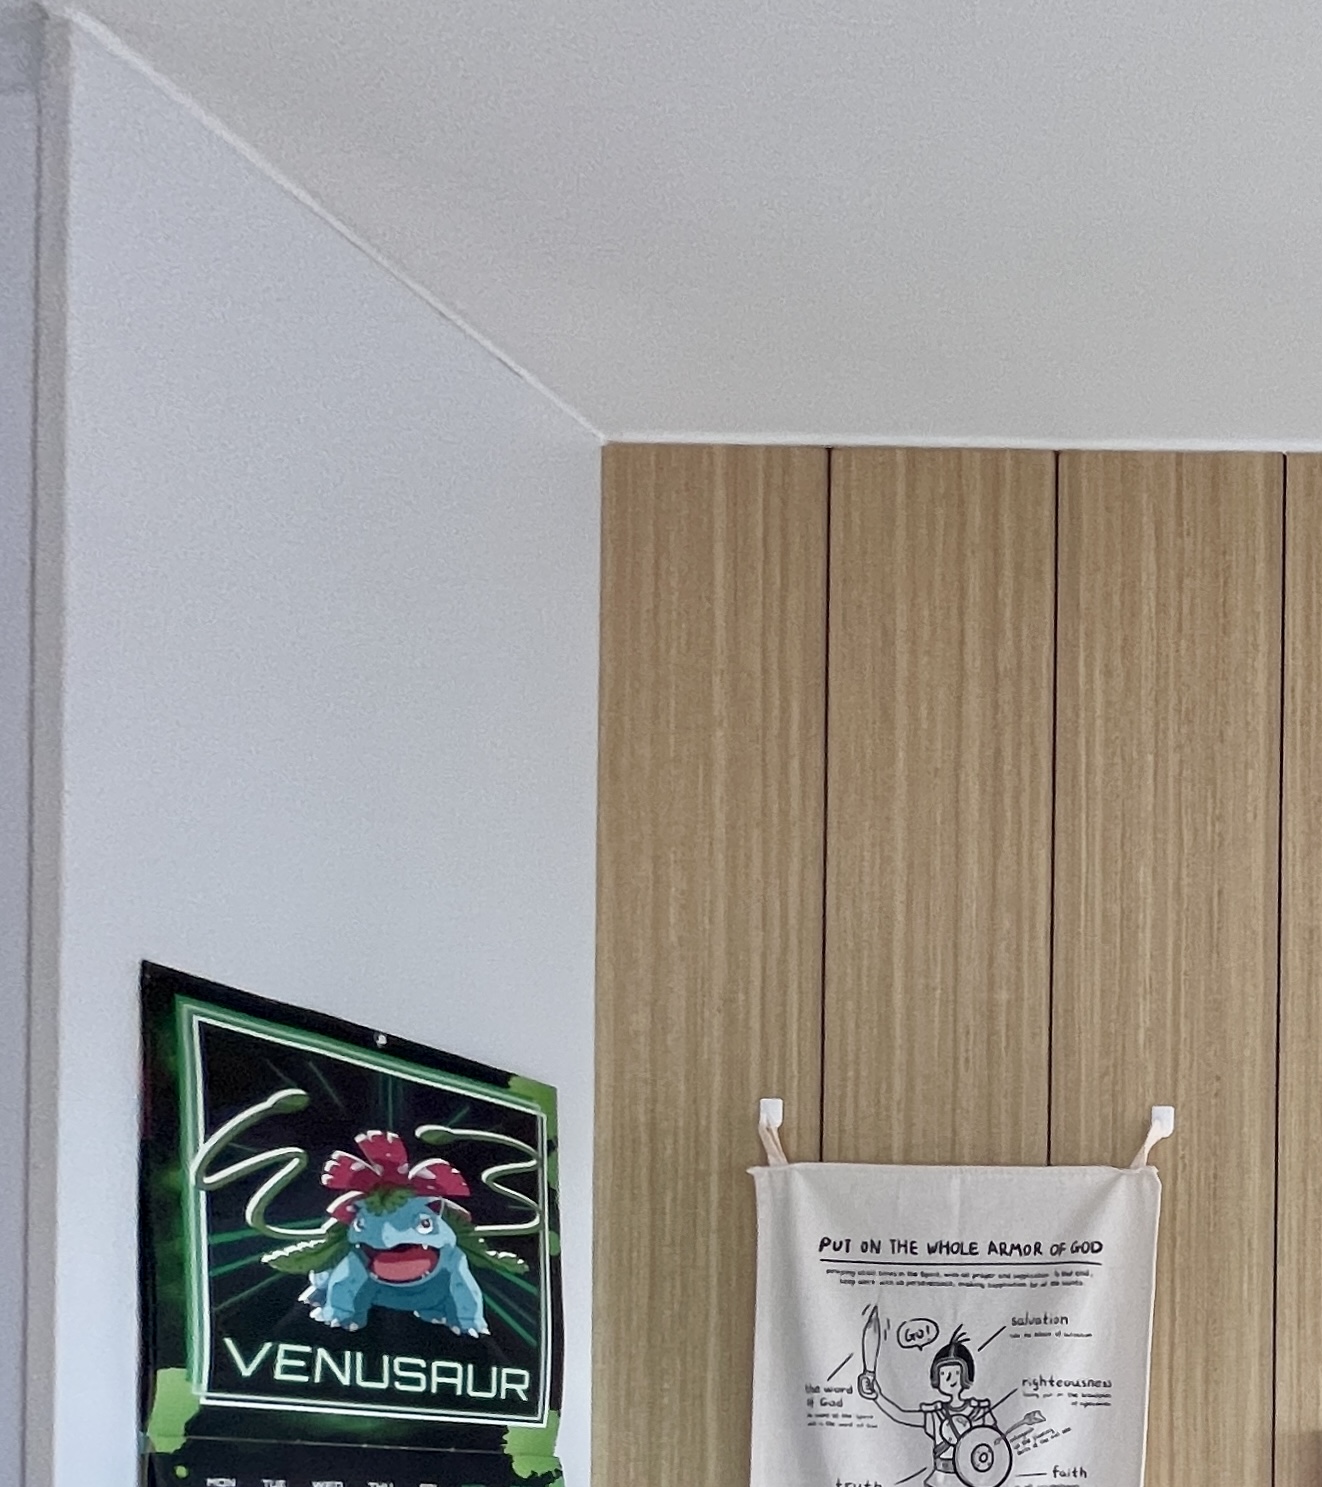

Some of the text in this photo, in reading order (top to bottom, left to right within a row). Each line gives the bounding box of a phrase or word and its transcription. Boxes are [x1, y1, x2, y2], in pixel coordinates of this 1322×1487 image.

[819, 1237, 1104, 1256] PUT ON THE WHOLE ARMOR OF GOD
[1011, 1311, 1069, 1326] salvation
[222, 1337, 531, 1402] VENUSAUR
[823, 1385, 853, 1395] word
[819, 1397, 844, 1408] God
[1052, 1465, 1087, 1478] faith
[206, 1477, 236, 1487] MON
